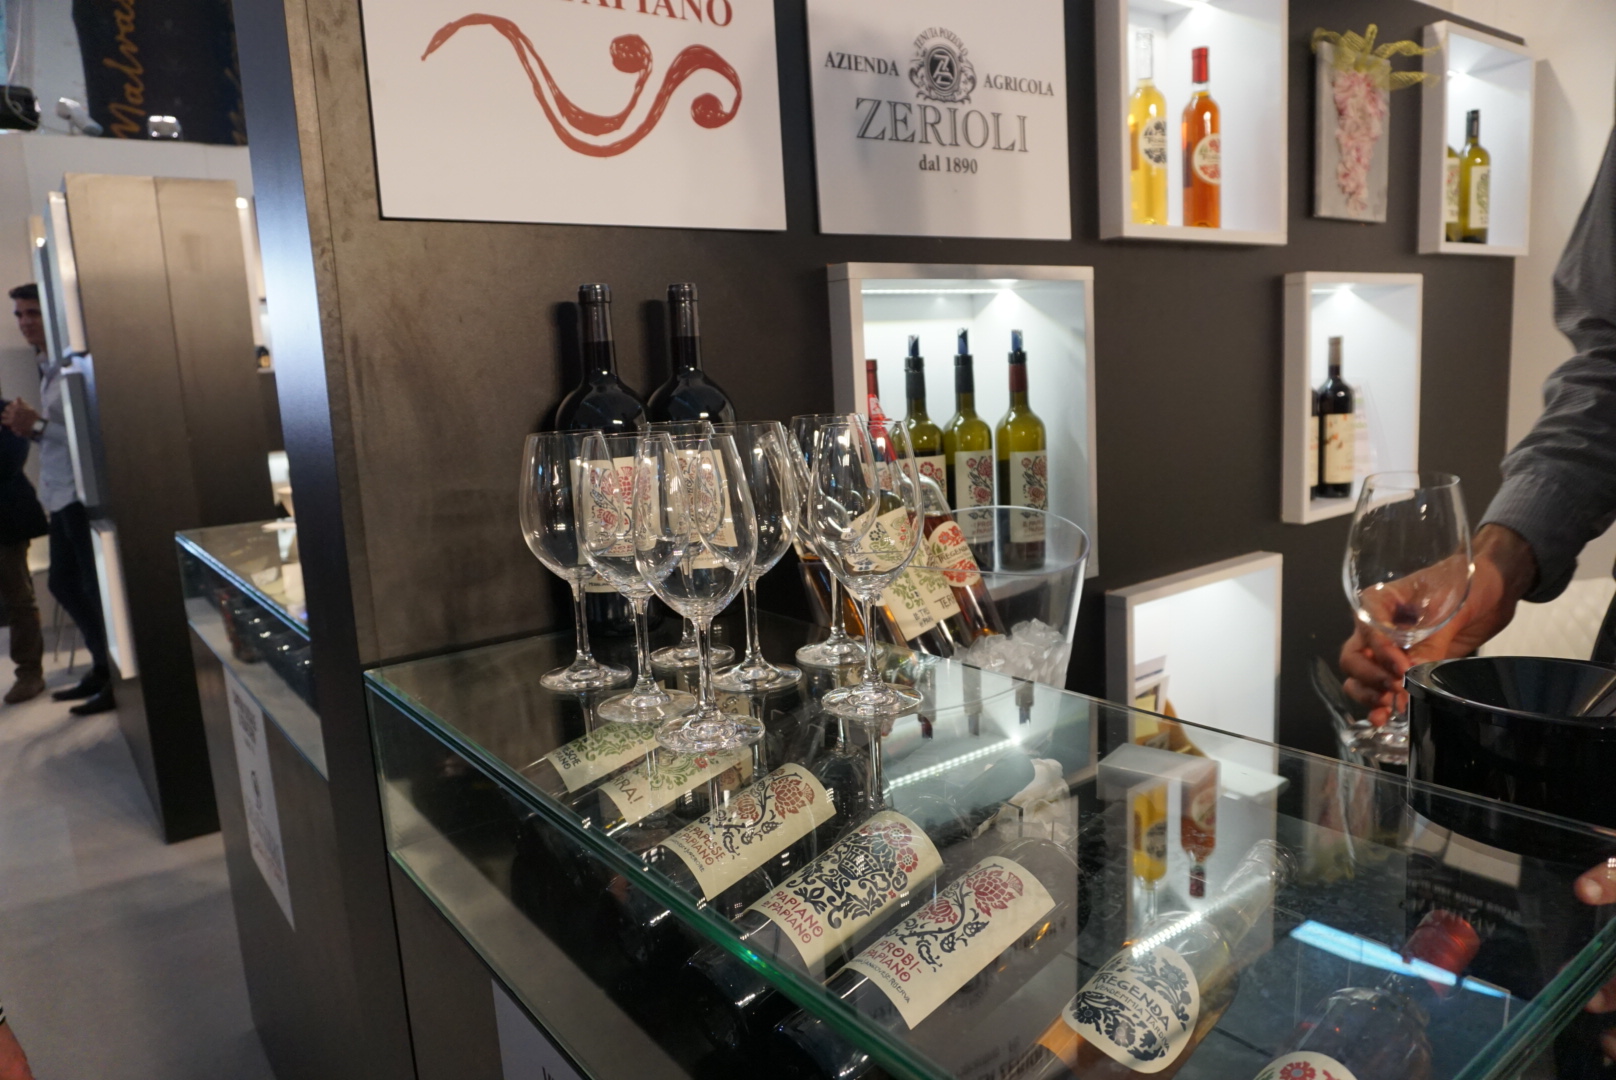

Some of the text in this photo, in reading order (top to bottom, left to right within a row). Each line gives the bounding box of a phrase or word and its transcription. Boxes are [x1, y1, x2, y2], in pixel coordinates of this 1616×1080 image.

[824, 51, 900, 77] AZIENDA
[983, 73, 1054, 97] AGRICOLA
[855, 97, 1029, 153] ZERIOLI
[919, 155, 978, 174] dal 1890
[767, 901, 812, 944] PAPIANO
[771, 890, 824, 938] PAPIANO
[866, 949, 911, 983] PAPIANO
[1093, 972, 1170, 1032] TREGENDA
[1095, 983, 1170, 1053] VENDEMMIA TARDIVA
